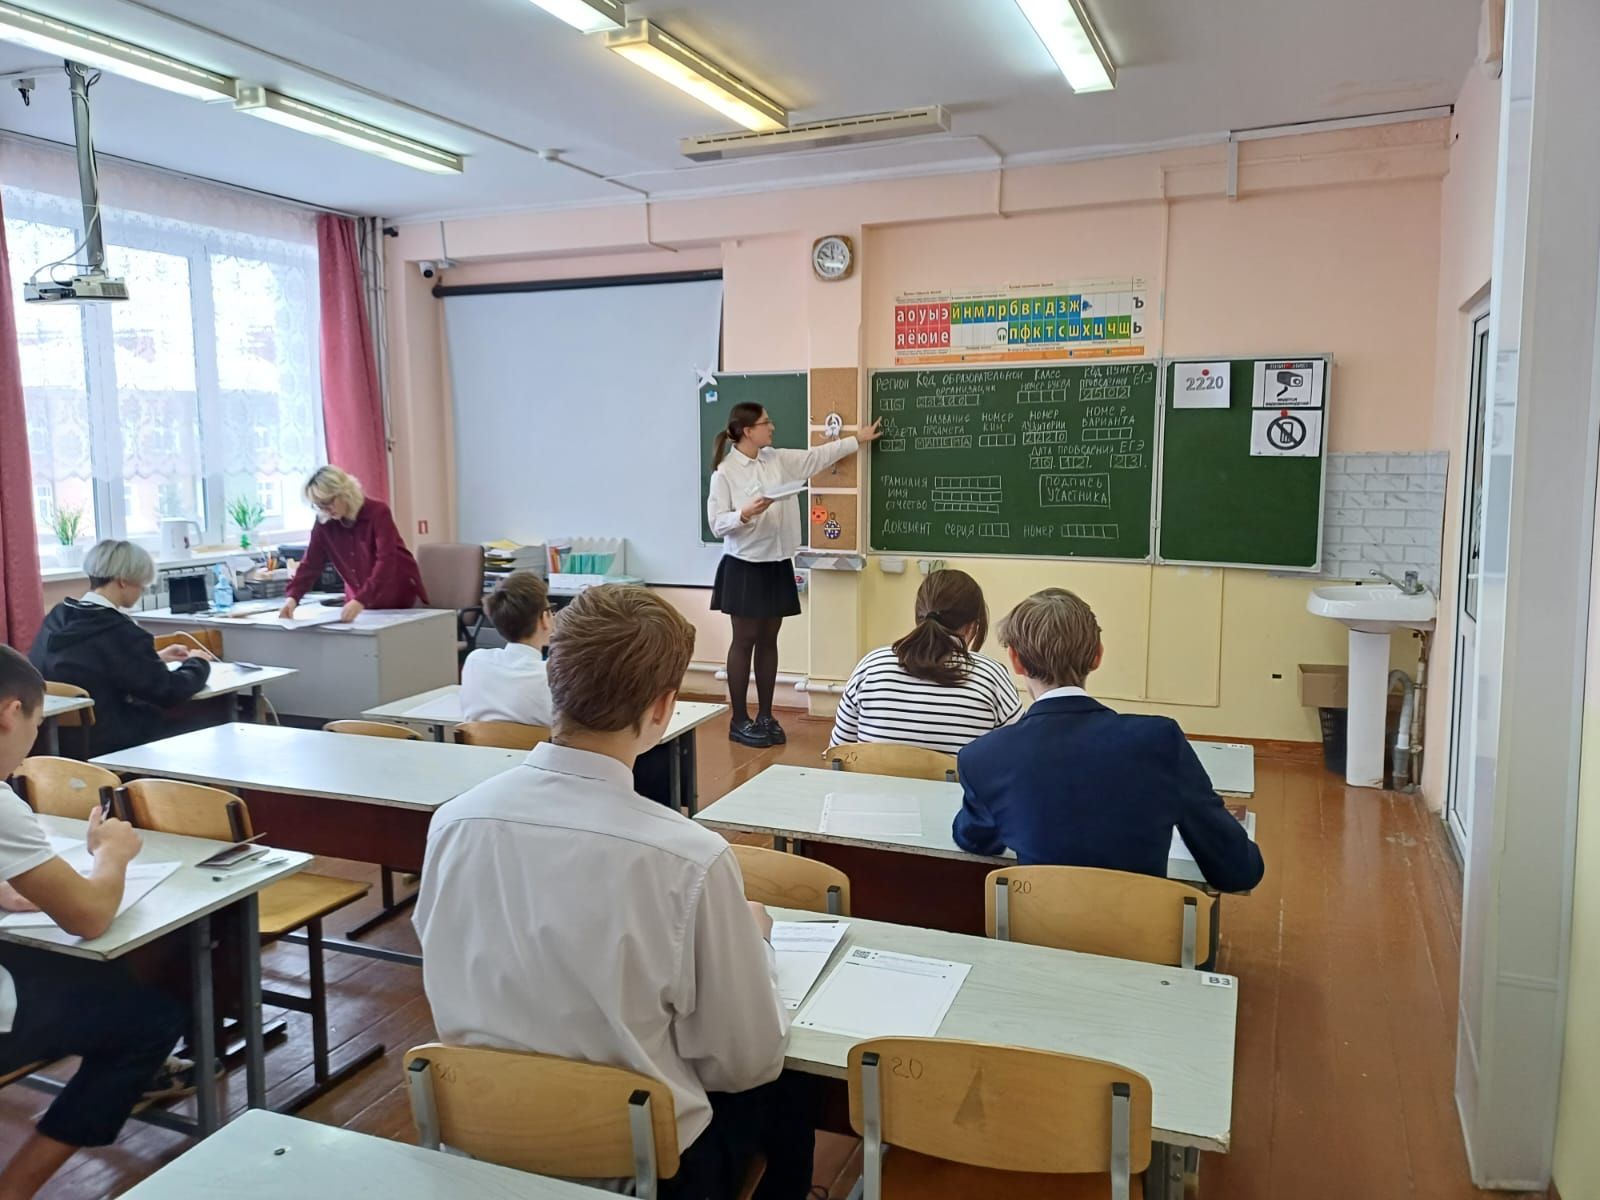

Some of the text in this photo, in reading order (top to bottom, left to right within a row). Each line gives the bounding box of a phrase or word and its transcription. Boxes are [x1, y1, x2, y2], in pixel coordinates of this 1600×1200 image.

[1186, 375, 1224, 391] 2220
[982, 411, 1014, 423] НОМЕР
[1120, 439, 1145, 453] ЕГЭ
[1045, 475, 1103, 488] ПОДПИСЬ
[1047, 487, 1107, 504] УЧАСТНИКА
[1013, 879, 1032, 895] 20
[891, 1056, 923, 1080] 20
